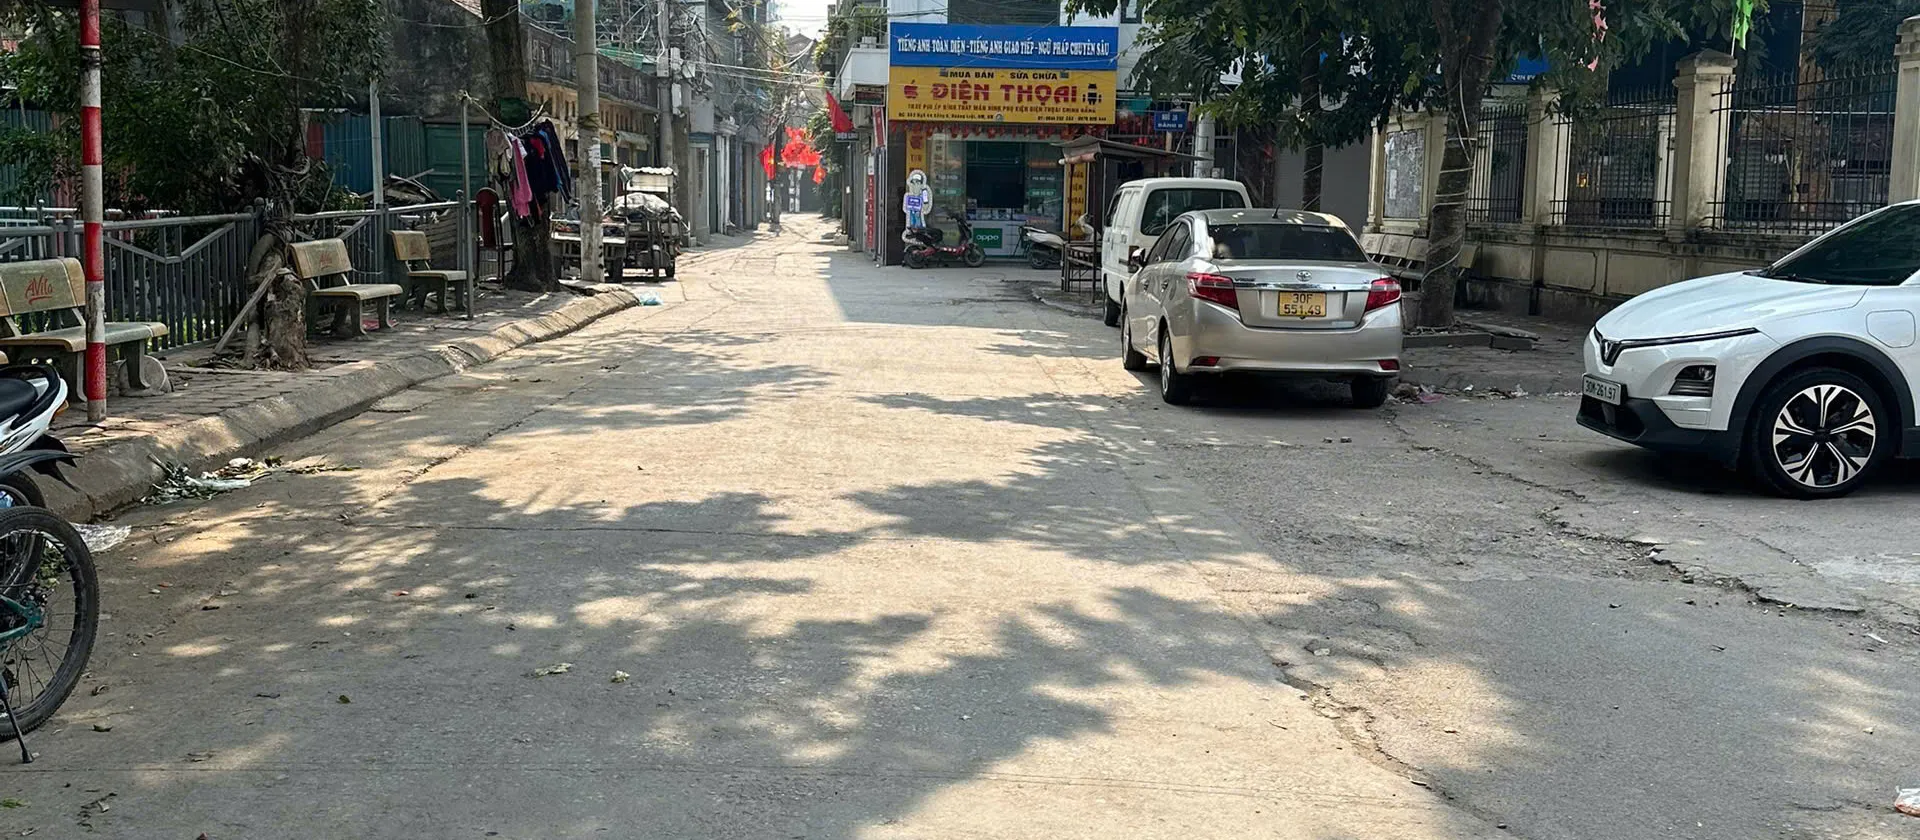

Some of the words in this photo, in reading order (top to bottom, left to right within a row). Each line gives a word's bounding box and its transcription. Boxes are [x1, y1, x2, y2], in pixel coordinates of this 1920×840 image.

[898, 33, 916, 52] TIẾNG
[917, 39, 930, 52] ANH
[932, 36, 949, 52] TOÀN
[950, 36, 966, 56] DIỆN
[970, 35, 988, 53] TIẾNG
[989, 40, 1003, 54] ANH
[1004, 41, 1019, 54] GIAO
[1020, 37, 1034, 54] TIẾP
[1053, 39, 1069, 55] PHÁP
[949, 71, 971, 79] MUA
[931, 80, 990, 104] ĐIỆN
[1292, 293, 1313, 304] 30F
[1283, 304, 1321, 316] 551.49
